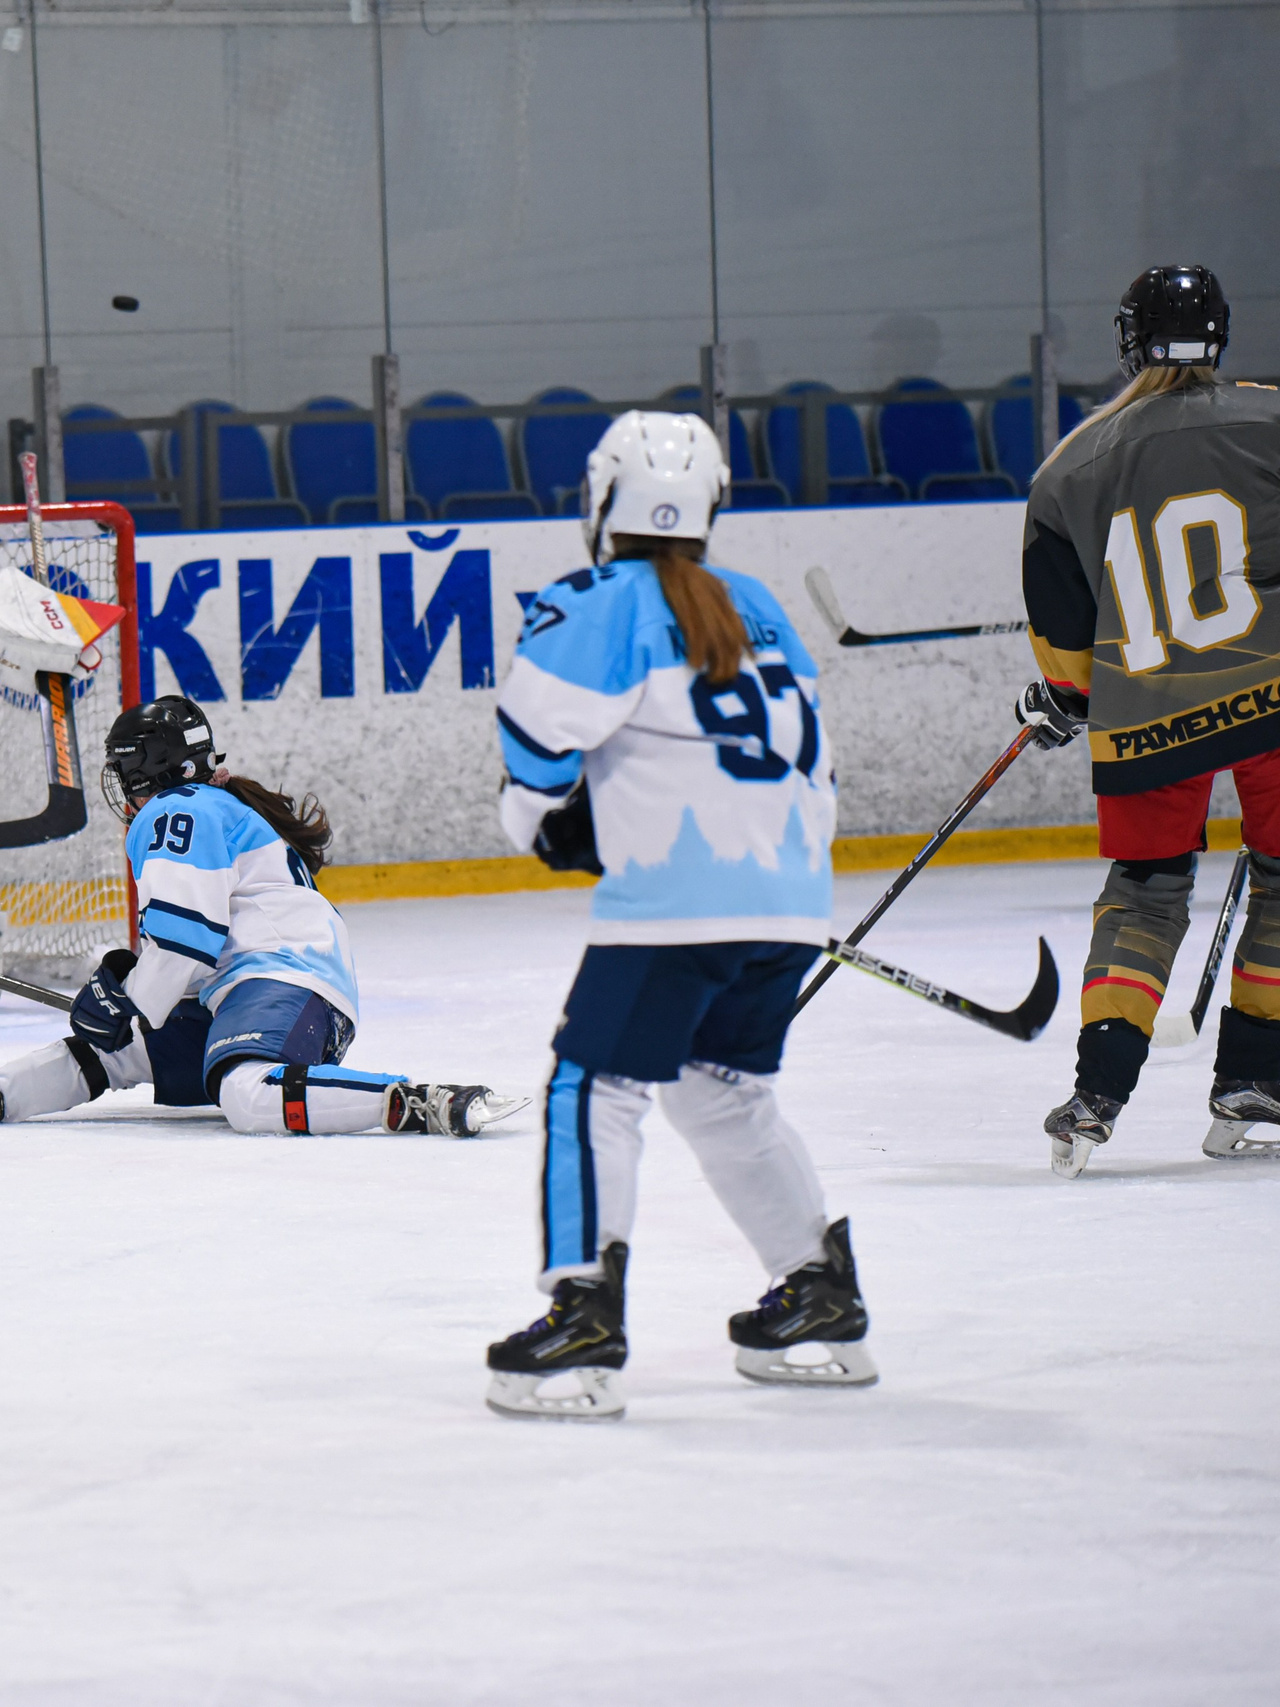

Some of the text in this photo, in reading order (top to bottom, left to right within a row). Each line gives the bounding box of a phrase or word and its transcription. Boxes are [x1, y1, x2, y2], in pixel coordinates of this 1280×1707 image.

[40, 600, 64, 630] CCM
[1103, 489, 1263, 677] 10
[688, 663, 820, 783] 97
[1109, 682, 1280, 759] РАМЕНСК
[835, 942, 948, 1003] FISCHER
